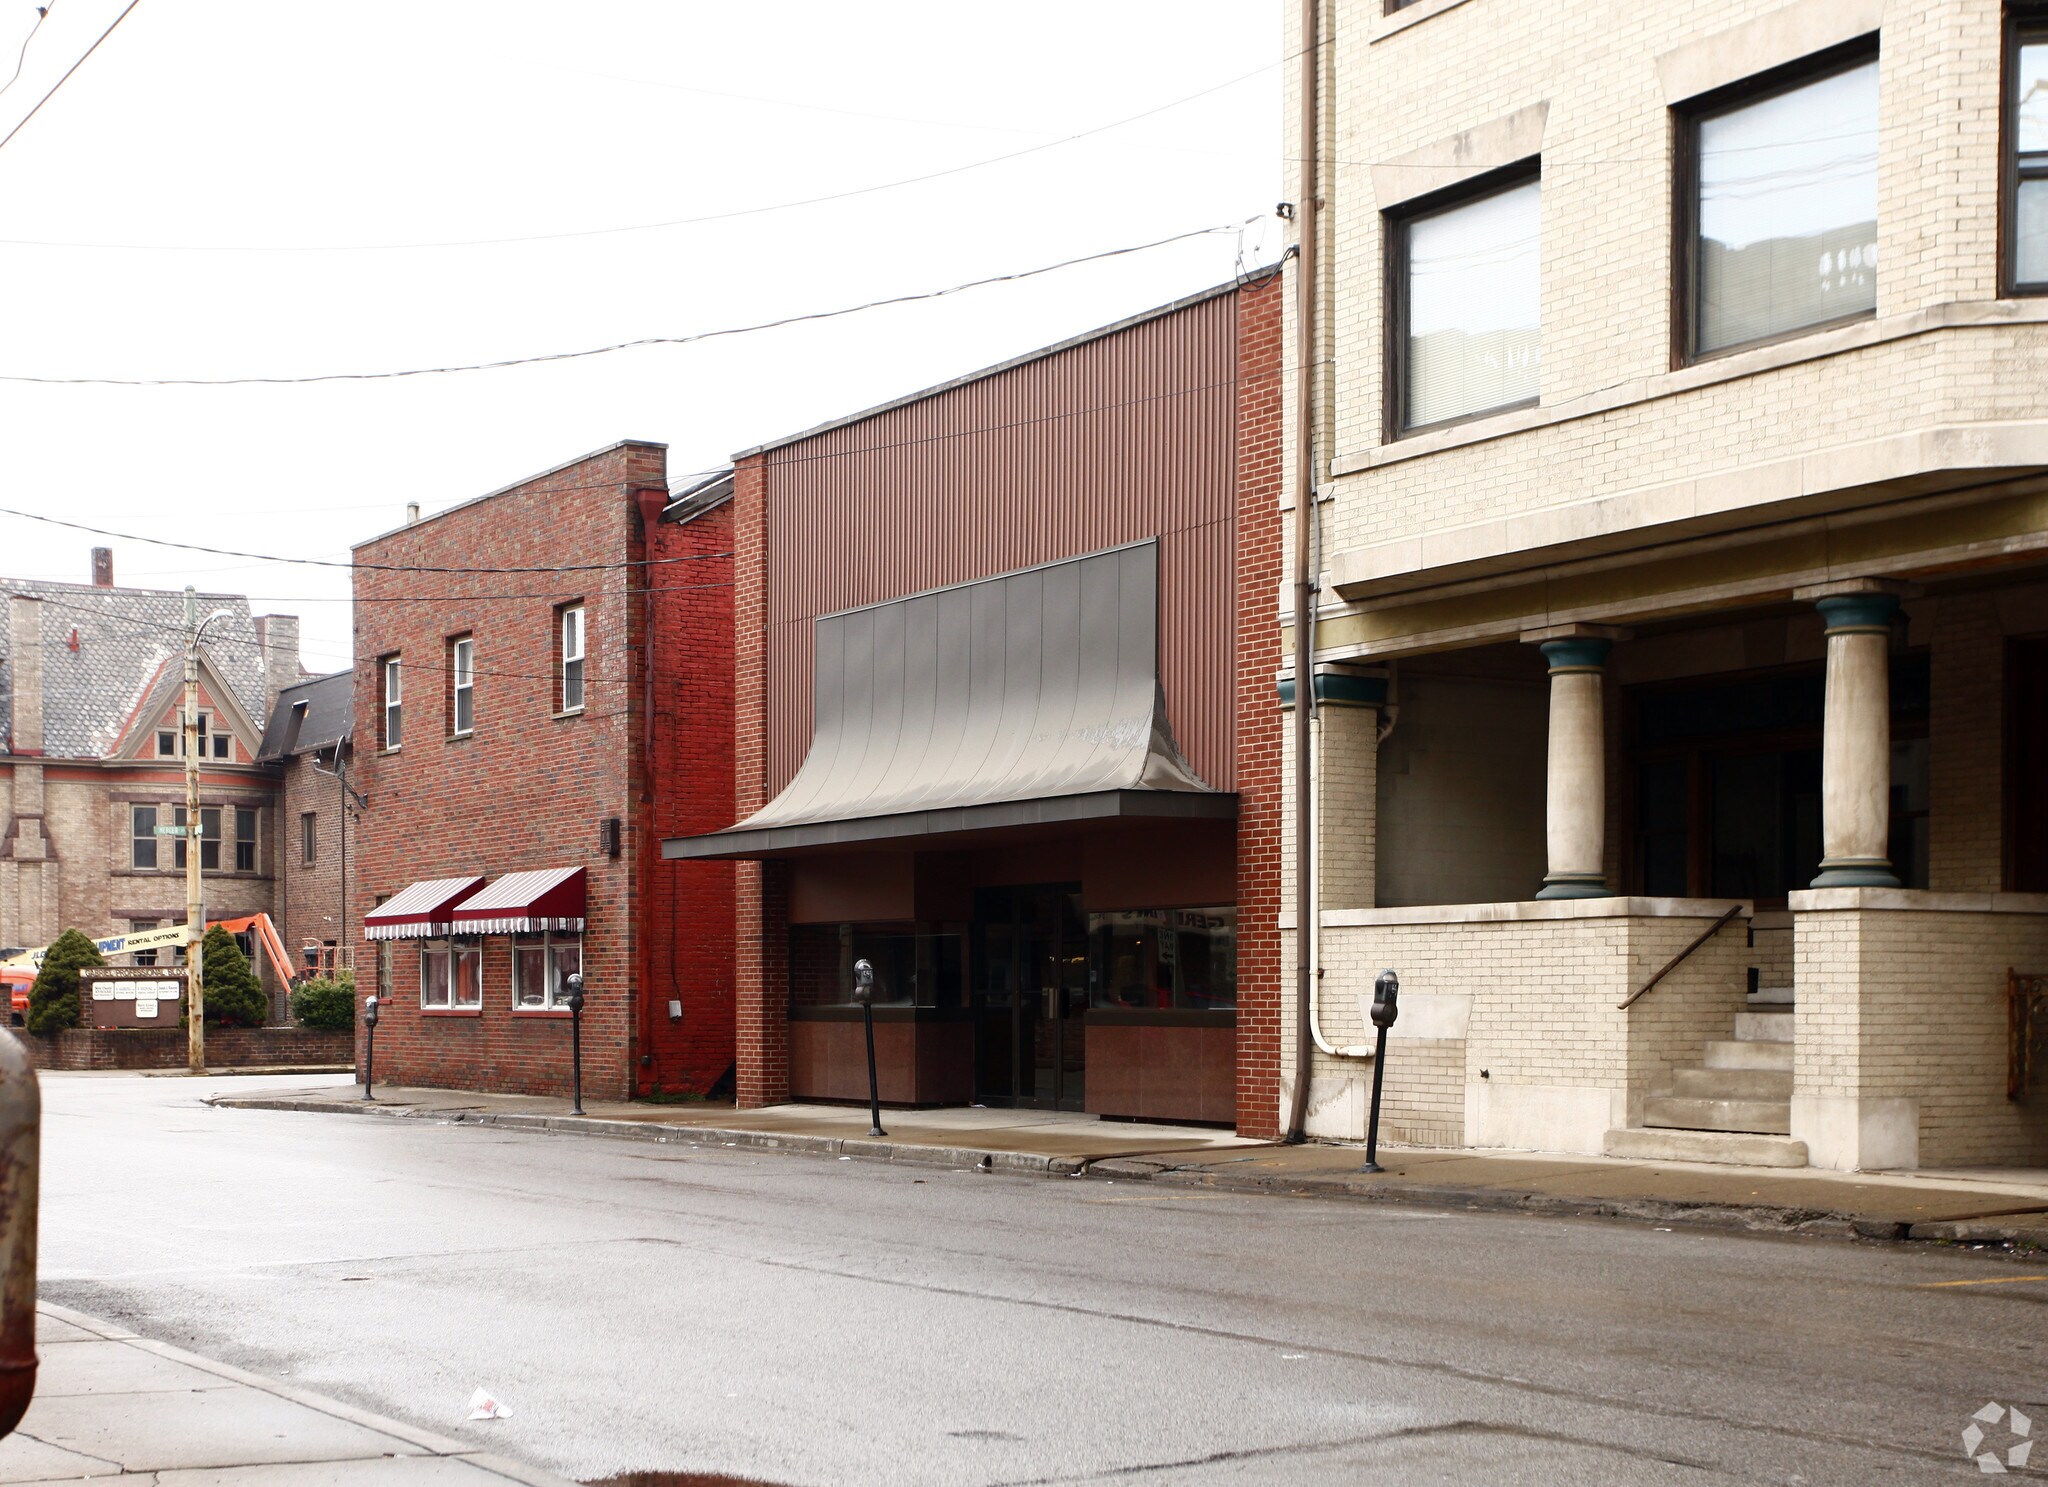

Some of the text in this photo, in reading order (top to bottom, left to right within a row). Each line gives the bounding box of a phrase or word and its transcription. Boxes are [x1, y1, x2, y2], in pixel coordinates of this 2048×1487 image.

[96, 932, 180, 953] IPMENT RENTAL OPTIONS
[115, 967, 164, 977] PROFESSIONAL
